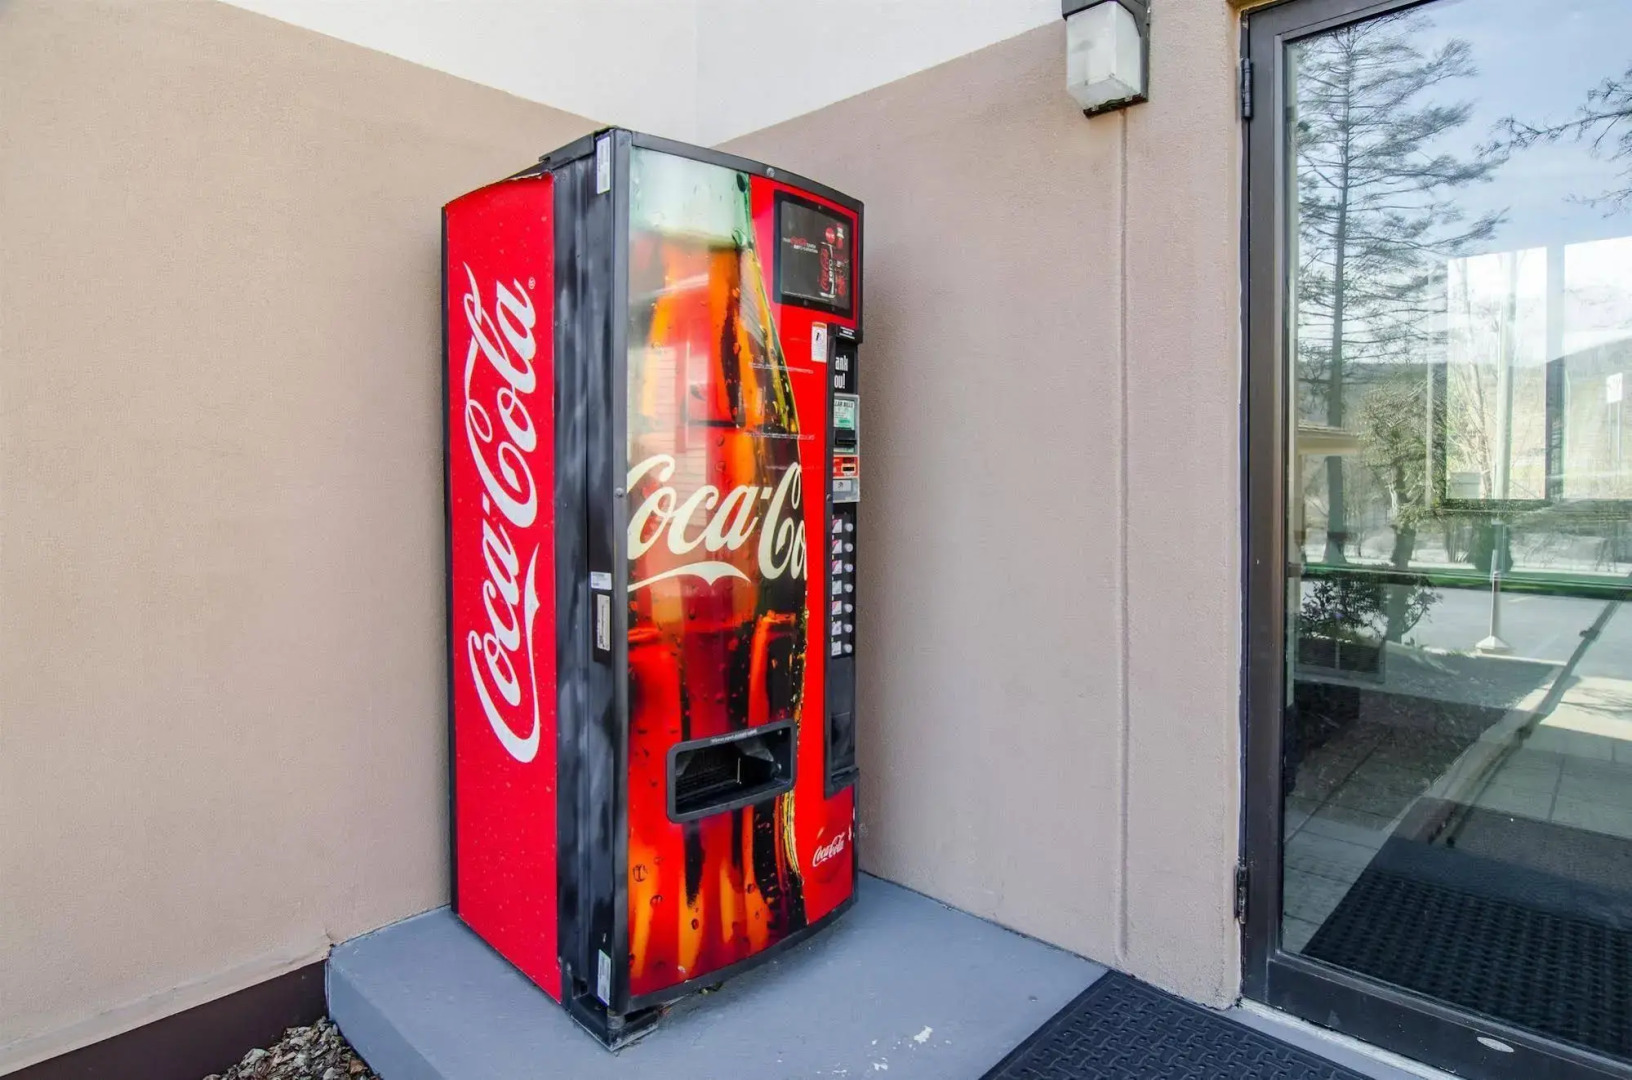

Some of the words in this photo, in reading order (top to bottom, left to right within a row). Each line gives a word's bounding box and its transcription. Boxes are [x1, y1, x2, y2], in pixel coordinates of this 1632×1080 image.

[834, 354, 849, 371] ank
[834, 372, 846, 389] ou!
[463, 260, 541, 764] Coca-Cola
